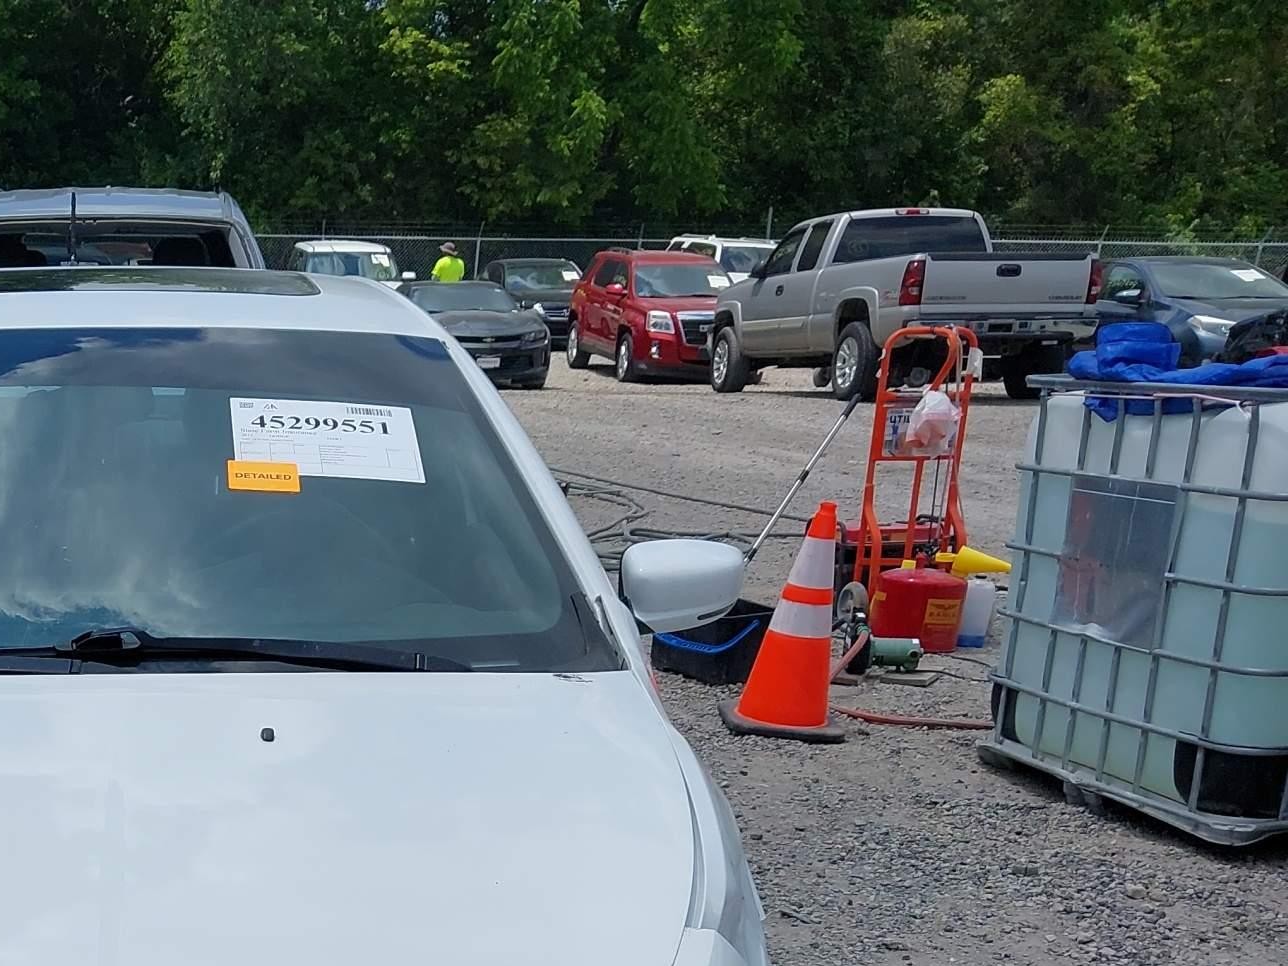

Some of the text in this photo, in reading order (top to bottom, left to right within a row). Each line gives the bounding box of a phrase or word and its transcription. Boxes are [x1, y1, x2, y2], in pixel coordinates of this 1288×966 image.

[889, 415, 911, 424] UTIL
[250, 414, 393, 436] 45299551
[234, 472, 293, 481] DETAILED
